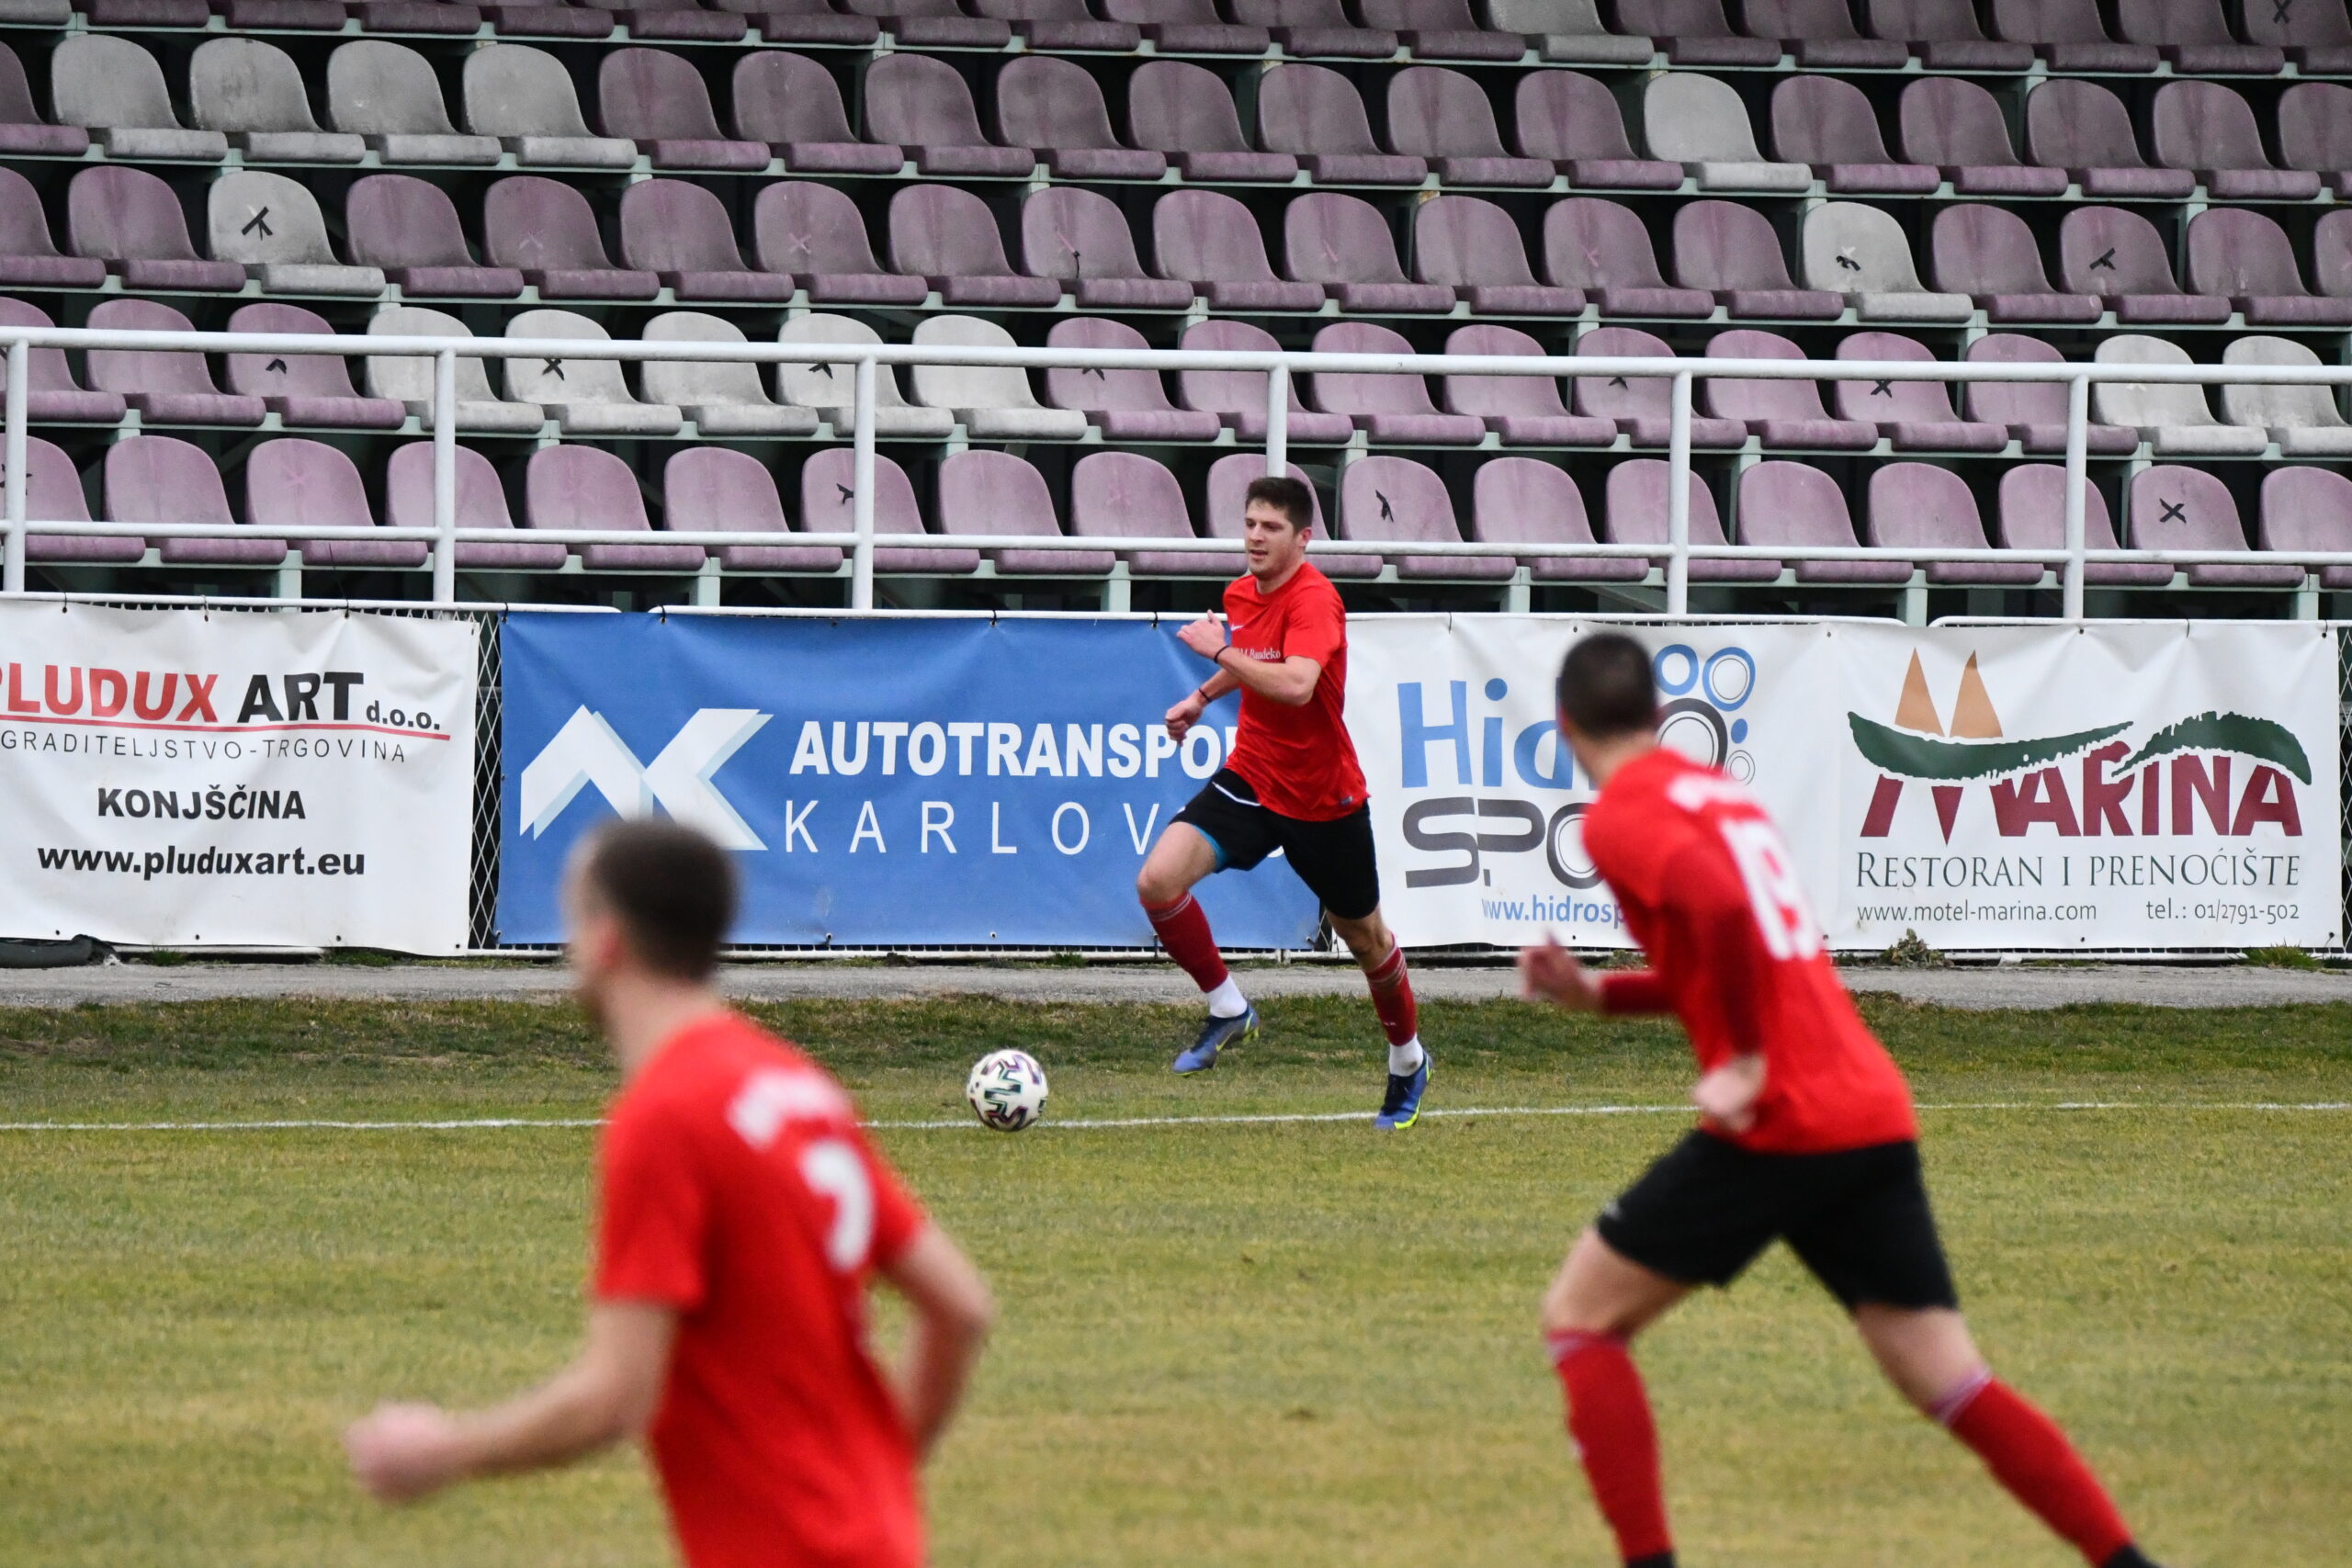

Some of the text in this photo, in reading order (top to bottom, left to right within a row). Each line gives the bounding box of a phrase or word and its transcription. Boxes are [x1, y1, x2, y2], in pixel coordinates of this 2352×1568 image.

[0, 661, 442, 730] LUDUX ART d.o.o.
[1396, 676, 1601, 790] Hid
[96, 784, 308, 821] KONJŠČINA
[1859, 740, 2303, 846] MARINA
[785, 800, 1285, 859] KARLOV
[1401, 795, 1605, 890] SPO
[37, 844, 367, 882] www.pluduxart.eu
[1481, 894, 1628, 930] www.hidrosp
[1857, 899, 2098, 921] www.motel-marina.com
[2145, 897, 2301, 925] tel.: 01/2791-502
